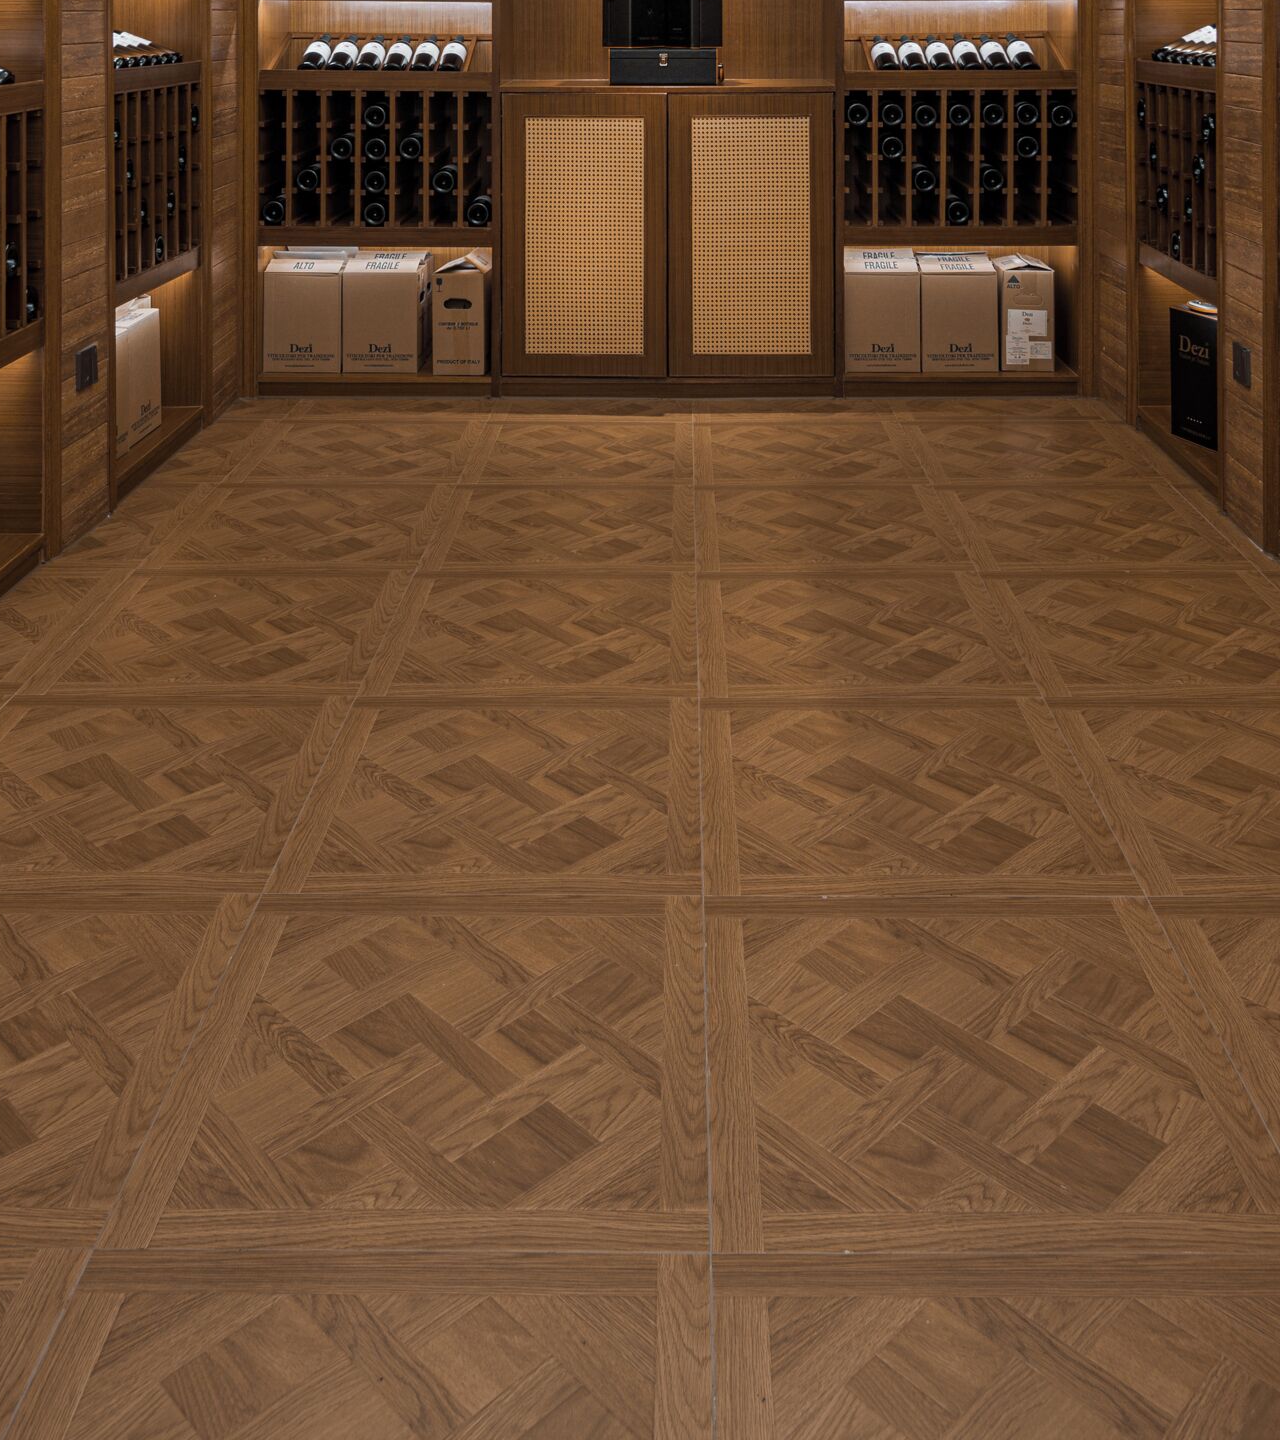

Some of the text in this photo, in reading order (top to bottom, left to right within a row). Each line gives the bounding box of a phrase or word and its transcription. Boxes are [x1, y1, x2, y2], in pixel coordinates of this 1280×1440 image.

[862, 251, 895, 259] FRAGILE
[293, 262, 315, 270] ALTO
[365, 261, 400, 270] FRAGILE
[864, 261, 899, 270] FRAGILE
[289, 343, 313, 353] Dezi
[368, 343, 392, 353] Dezi
[872, 343, 895, 353] Dezi
[950, 343, 973, 353] Dezi
[1178, 334, 1209, 359] Dezi
